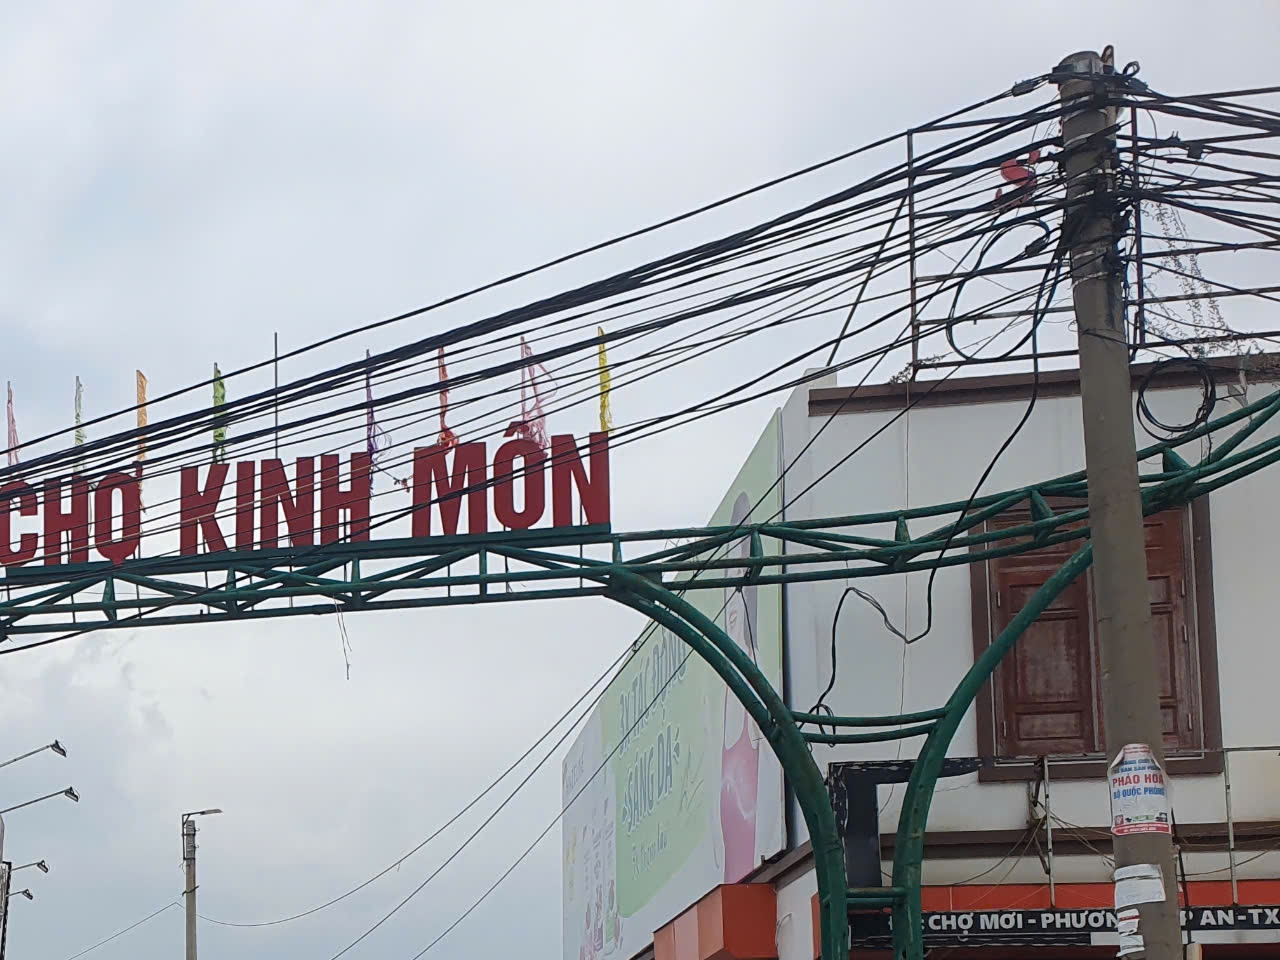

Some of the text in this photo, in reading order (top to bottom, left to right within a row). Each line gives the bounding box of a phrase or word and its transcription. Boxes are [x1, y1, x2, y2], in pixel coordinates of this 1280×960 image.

[180, 450, 370, 556] KINH
[412, 420, 611, 537] MÔN
[928, 911, 973, 935] CHỢ
